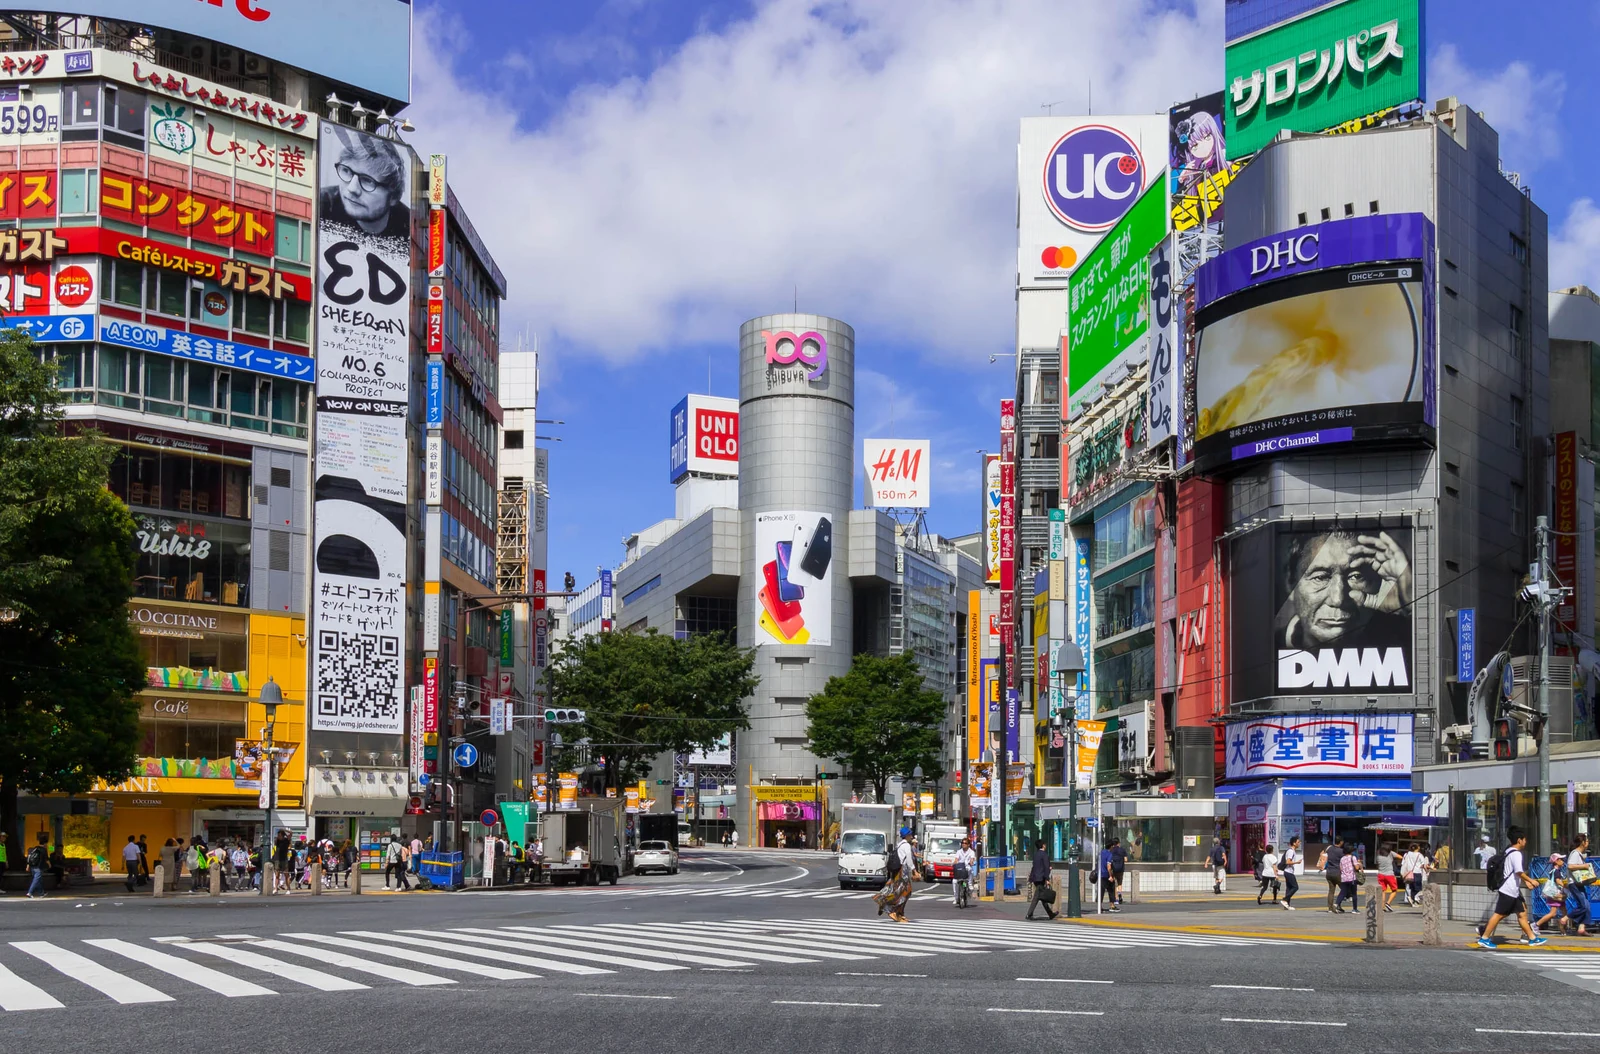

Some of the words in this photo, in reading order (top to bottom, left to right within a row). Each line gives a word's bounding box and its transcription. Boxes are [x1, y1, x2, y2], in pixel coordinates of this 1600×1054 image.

[67, 55, 90, 69] 寿司
[1229, 18, 1404, 117] サロンパス
[132, 61, 308, 130] しゃぶしゃぶバイキング
[206, 122, 307, 178] しゃぶ葉
[102, 175, 269, 242] コンタクト
[1250, 232, 1319, 275] DHC
[59, 283, 90, 296] ガスト
[221, 259, 295, 299] ガスト
[1351, 271, 1385, 281] DHCビール
[61, 318, 83, 335] 6F
[106, 321, 159, 347] AEON
[322, 304, 406, 337] SHEERAN
[430, 313, 441, 346] ガスト
[171, 332, 312, 377] 英会話イーオン
[761, 330, 828, 381] 109
[1150, 246, 1172, 435] もんじゃ
[319, 369, 407, 392] COLLABORATIONS
[345, 383, 383, 397] PROJECT
[764, 369, 805, 385] SHIBUYA
[325, 399, 354, 410] NOW
[355, 402, 372, 412] ON
[372, 403, 398, 414] SALE
[700, 414, 734, 436] UNI
[700, 435, 738, 457] QLO
[1255, 439, 1278, 454] DHC
[1278, 432, 1320, 449] Channel
[429, 442, 438, 499] 渋谷駅前ビル
[871, 448, 923, 483] H&M
[1558, 435, 1573, 546] クスリのことなら
[763, 514, 783, 522] iPhone
[136, 530, 212, 560] Ushi8
[320, 582, 400, 603] #エドコラボ
[1558, 553, 1574, 623] 三里
[320, 600, 399, 616] でツイートしてギフト
[320, 611, 353, 625] カードを
[357, 615, 394, 632] ゲット!
[1461, 612, 1471, 678] 大盛堂商事ビル
[1277, 646, 1409, 689] DMM
[153, 699, 189, 717] Café
[426, 678, 435, 727] サンドラッグ
[317, 719, 399, 731] https://wmg.jp/edsheeran/
[1231, 726, 1397, 766] 大盛堂書店
